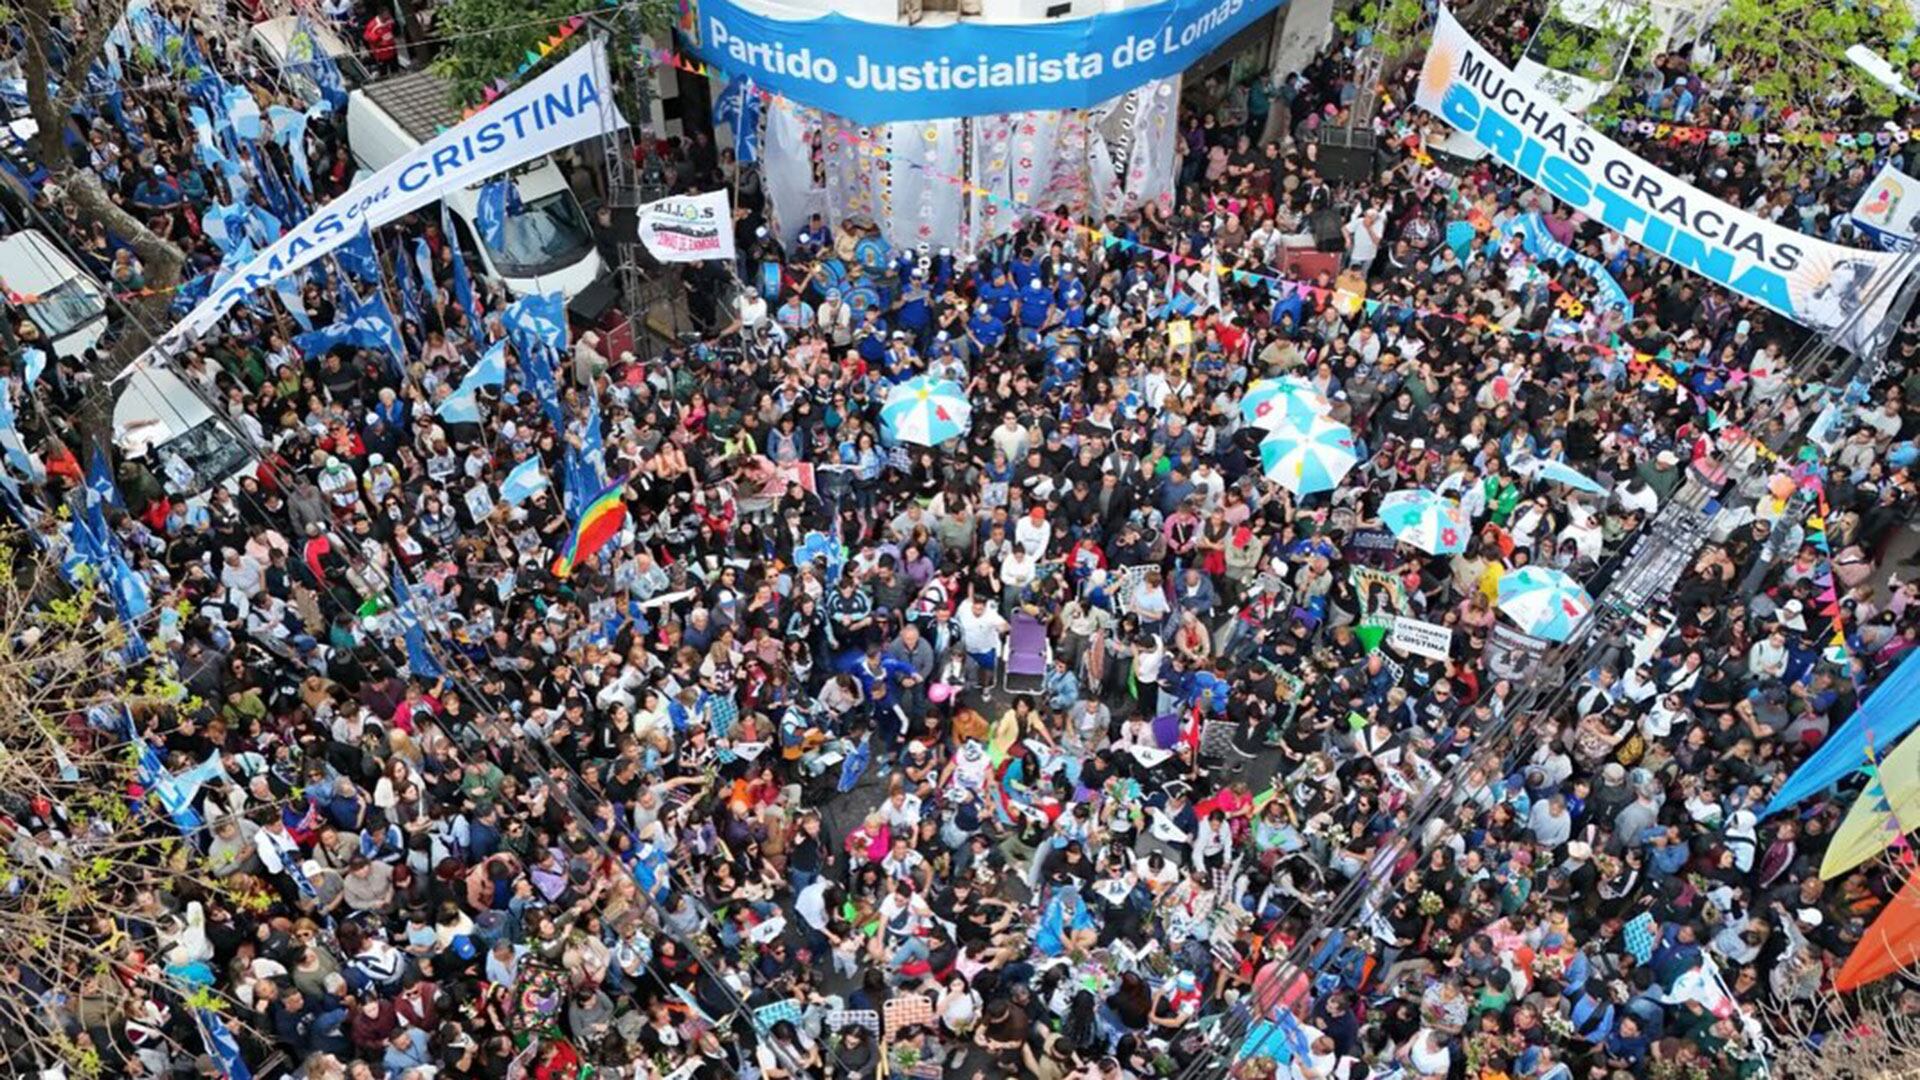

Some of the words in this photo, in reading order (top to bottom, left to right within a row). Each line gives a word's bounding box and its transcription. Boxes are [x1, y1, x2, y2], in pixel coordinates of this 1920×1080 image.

[710, 16, 837, 84] Partido
[846, 51, 1104, 91] Justicialista
[1112, 35, 1157, 69] de
[1163, 0, 1243, 54] Lomas
[346, 185, 390, 219] con
[398, 72, 600, 193] CRISTINA
[1441, 81, 1795, 317] CRISTINA
[1458, 50, 1595, 165] MUCHAS
[1603, 159, 1804, 271] GRACIAS
[1396, 634, 1446, 653] CRISTINA
